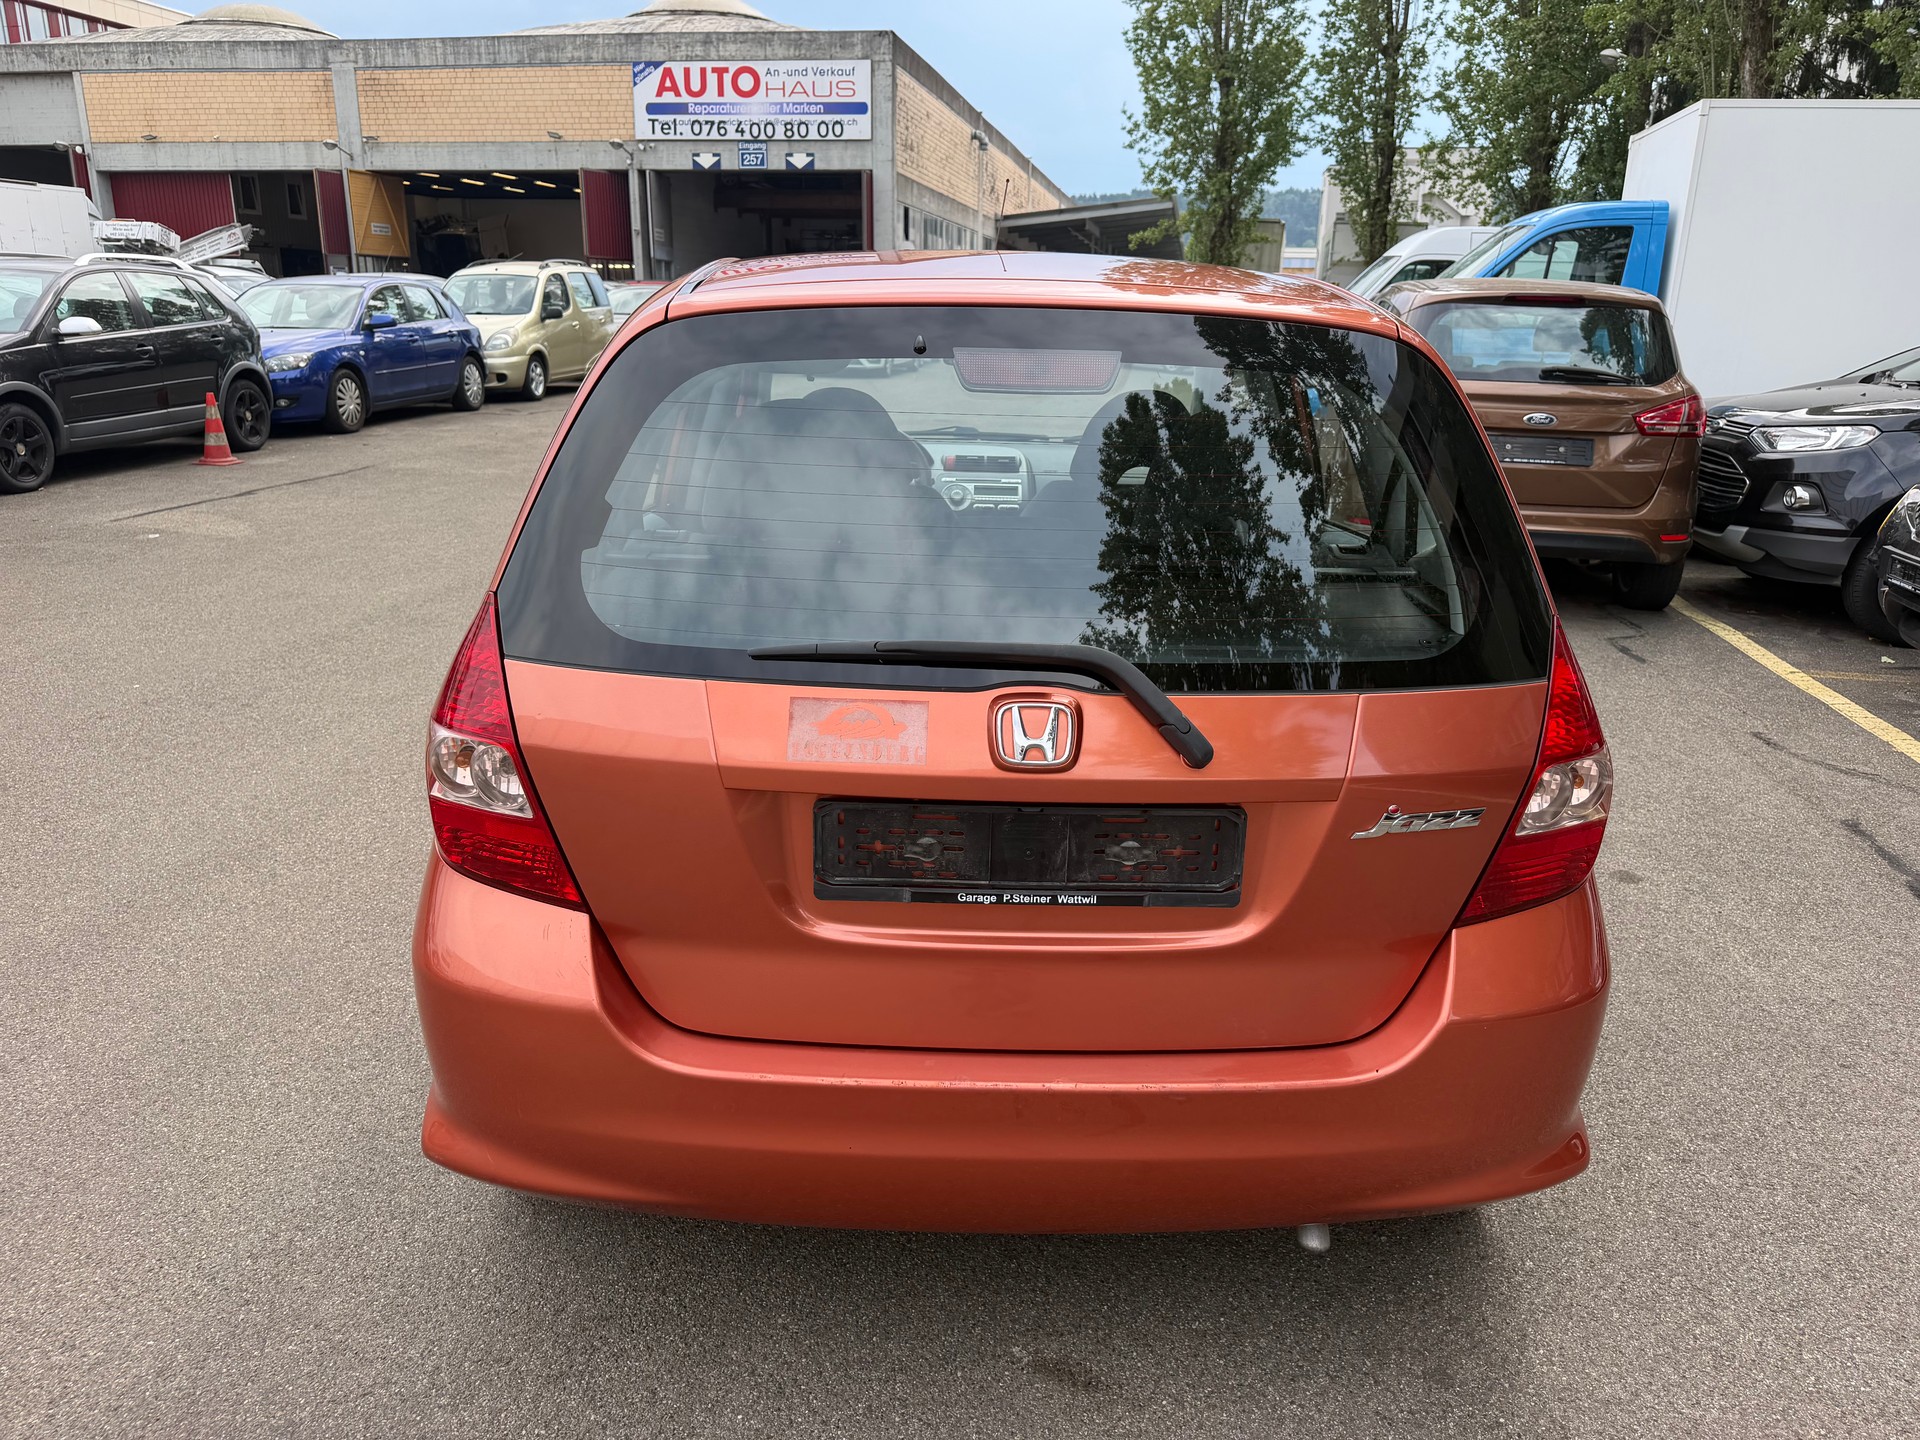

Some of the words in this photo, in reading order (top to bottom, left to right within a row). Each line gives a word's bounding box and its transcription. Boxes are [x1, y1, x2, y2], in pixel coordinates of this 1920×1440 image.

[765, 67, 780, 77] An
[811, 66, 855, 77] Verkauf
[655, 65, 761, 98] AUTO
[765, 80, 856, 98] HAUS
[783, 103, 823, 114] Marken
[648, 118, 683, 136] Tel.
[691, 119, 728, 137] 076
[735, 120, 776, 139] 400
[784, 121, 809, 138] 80
[817, 120, 844, 138] 00
[739, 141, 767, 151] Eingang
[743, 153, 763, 165] 257
[1530, 415, 1551, 424] Ford
[957, 892, 997, 904] Garage
[1003, 893, 1051, 904] P.Steiner
[1057, 894, 1097, 904] Wattwil
